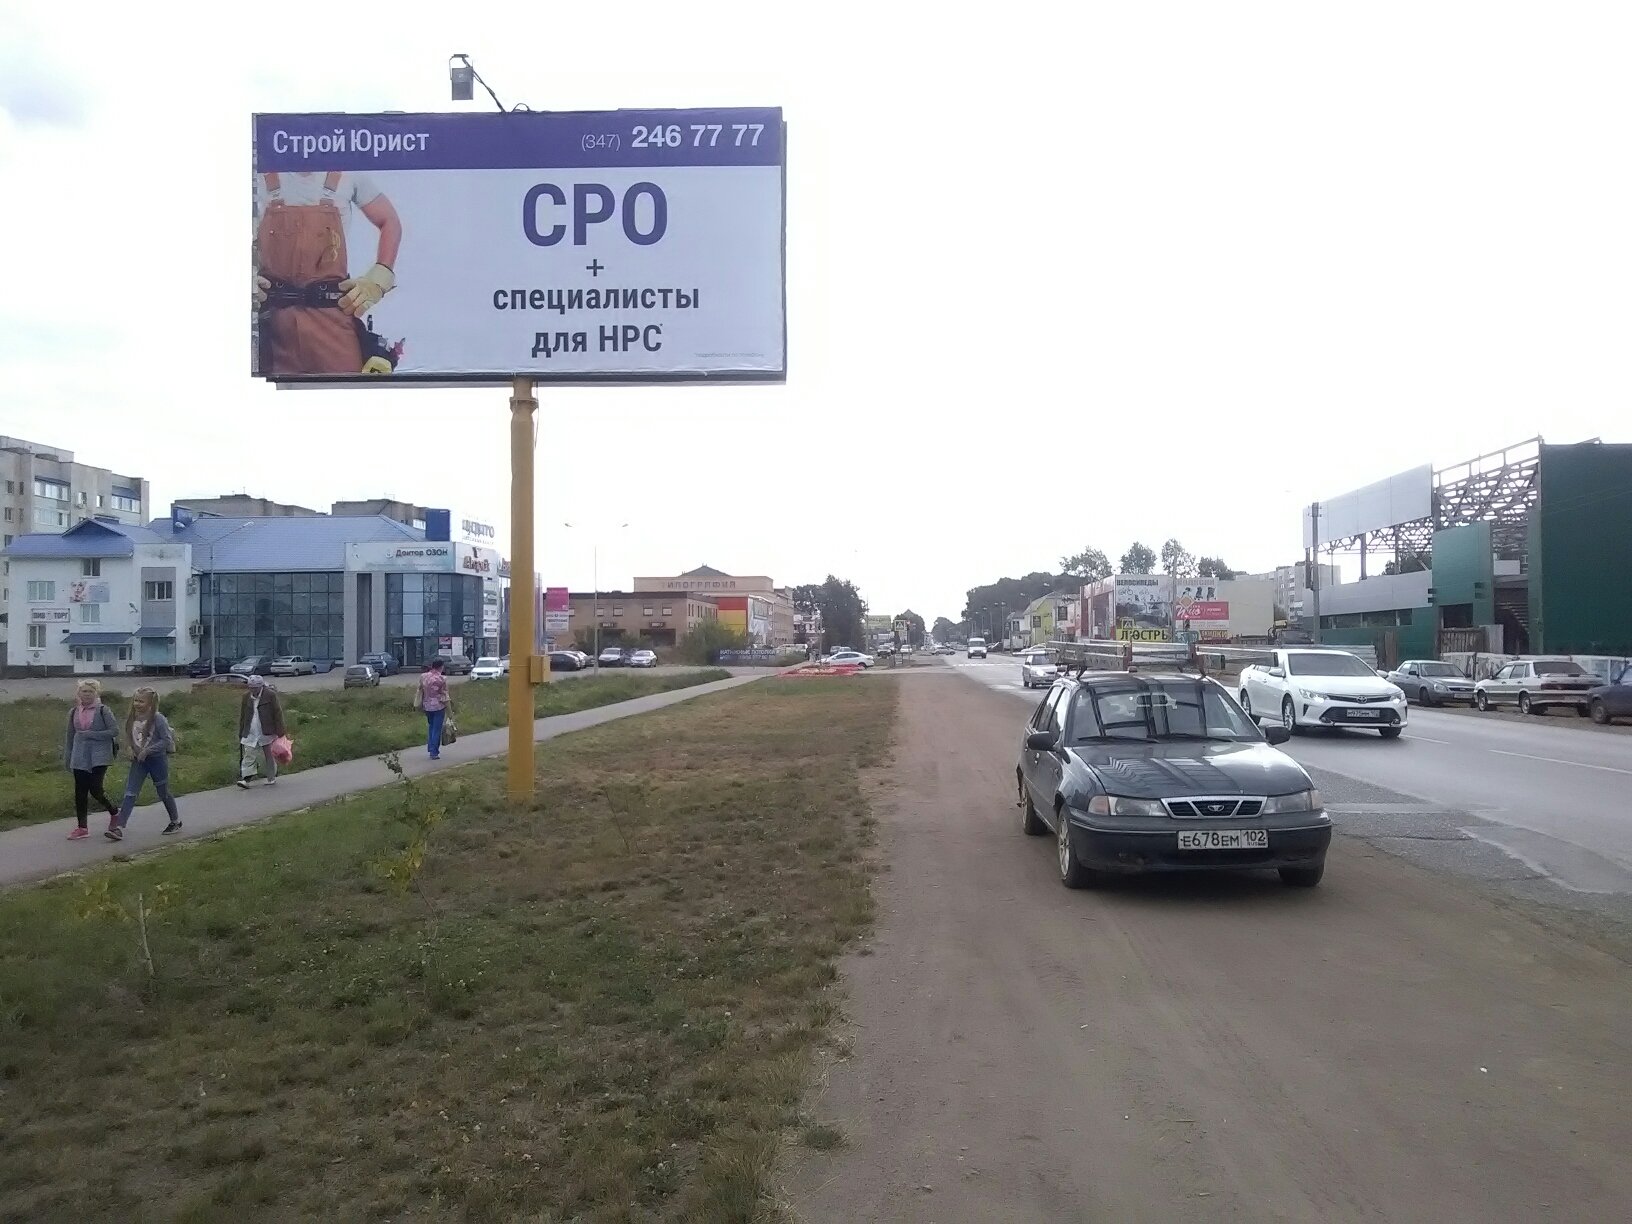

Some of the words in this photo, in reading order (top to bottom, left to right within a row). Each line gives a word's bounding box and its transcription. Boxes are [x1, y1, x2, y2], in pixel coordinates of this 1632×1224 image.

[273, 128, 346, 158] Строй
[350, 128, 430, 157] Юрист
[581, 133, 621, 151] (347)
[631, 125, 682, 148] 246
[690, 124, 723, 147] 77
[732, 124, 765, 147] 77
[522, 181, 668, 247] СРО
[493, 288, 699, 315] специалисты
[531, 332, 587, 358] для
[426, 548, 448, 556] ОЗОН
[1183, 832, 1240, 847] Е678ЕМ
[1243, 831, 1265, 842] 102
